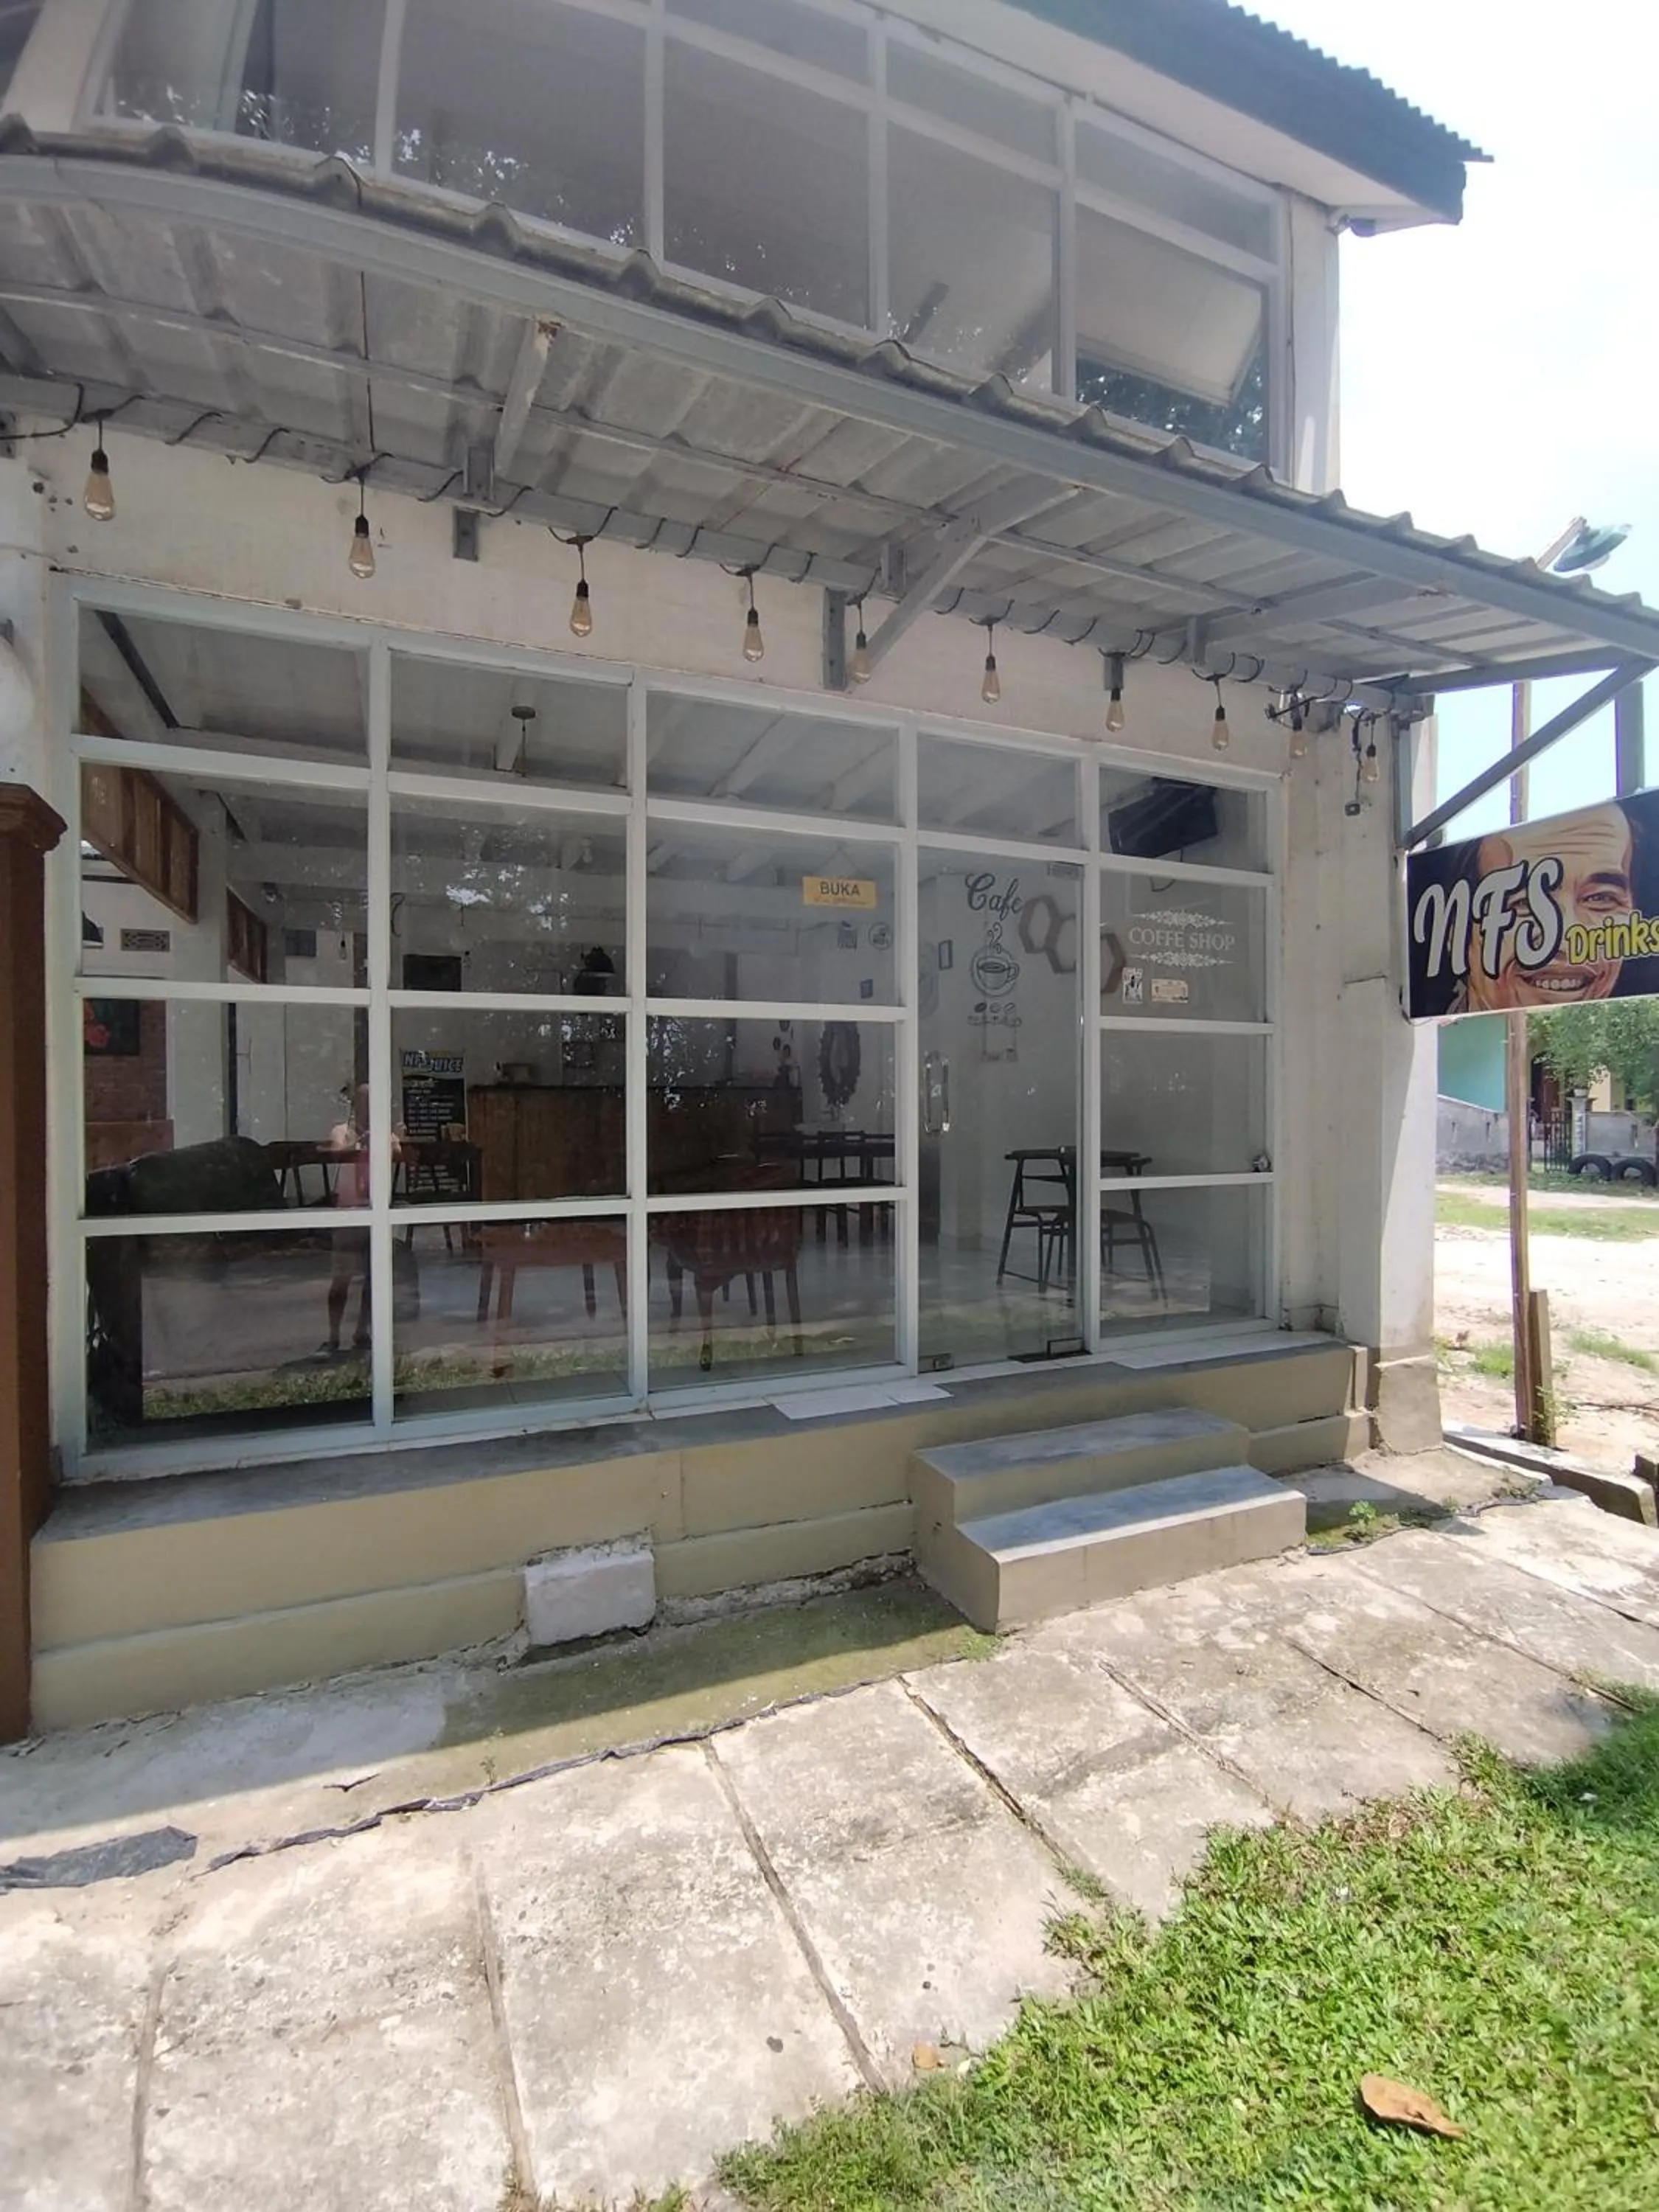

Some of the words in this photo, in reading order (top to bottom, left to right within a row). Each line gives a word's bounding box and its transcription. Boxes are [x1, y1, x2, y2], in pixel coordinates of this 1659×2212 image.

[820, 881, 860, 897] BUKA
[964, 872, 1023, 922] Cafe
[1413, 857, 1564, 979] NFS
[1565, 910, 1659, 964] Drinks
[1128, 927, 1185, 948] COFFE
[1189, 933, 1236, 951] SHOP
[427, 1057, 463, 1073] JUICE
